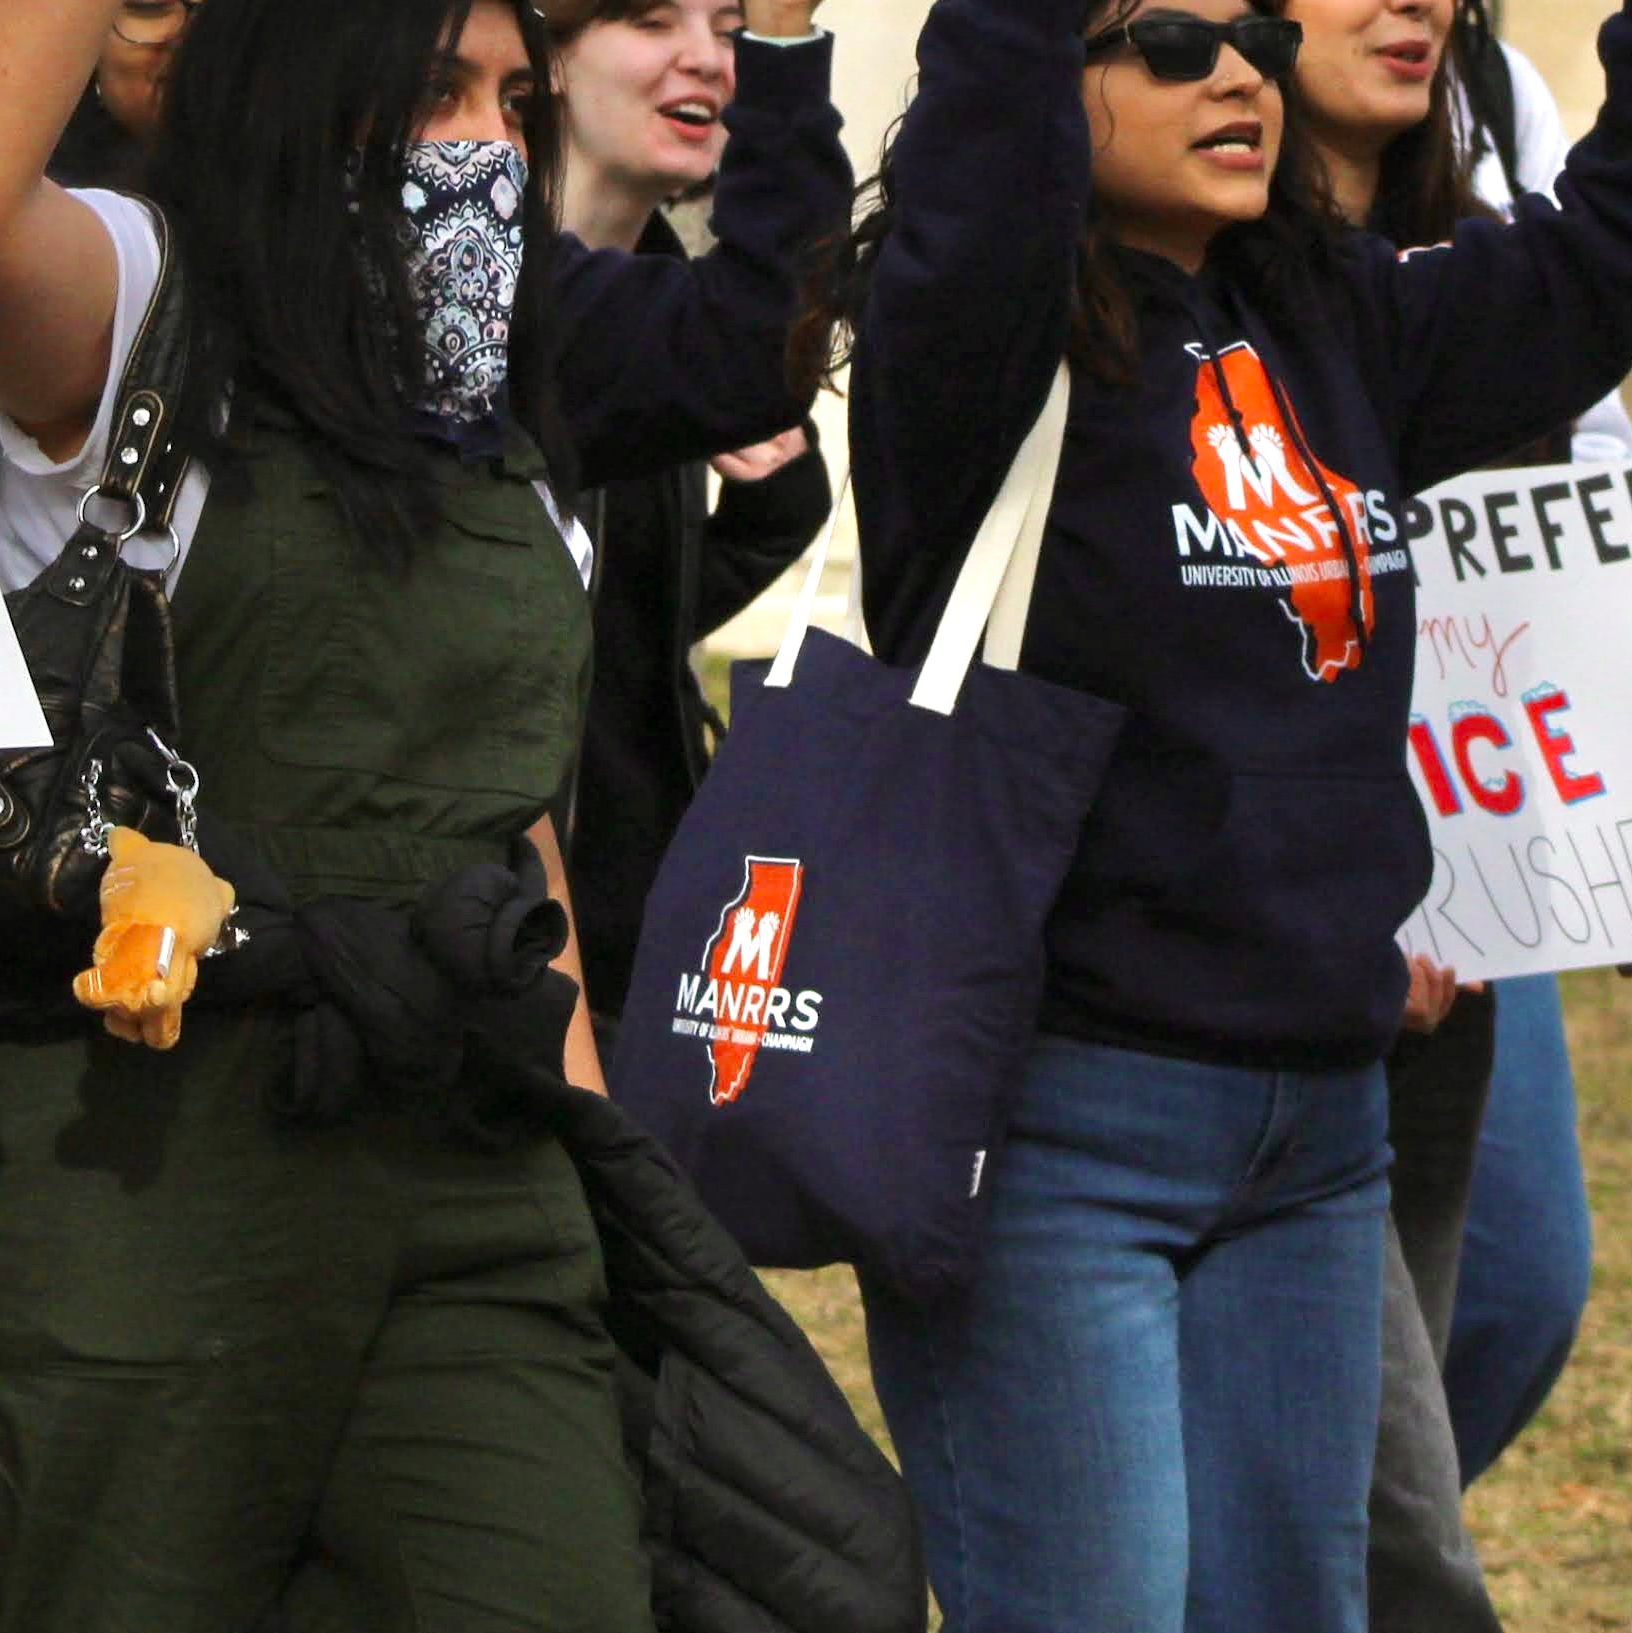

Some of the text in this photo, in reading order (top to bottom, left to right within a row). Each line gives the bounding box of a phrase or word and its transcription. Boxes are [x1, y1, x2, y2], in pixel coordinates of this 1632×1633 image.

[1181, 564, 1256, 587] UNIVERSITY
[1419, 614, 1530, 698] my
[1407, 682, 1607, 819] ICE
[676, 972, 824, 1031] MANRRS
